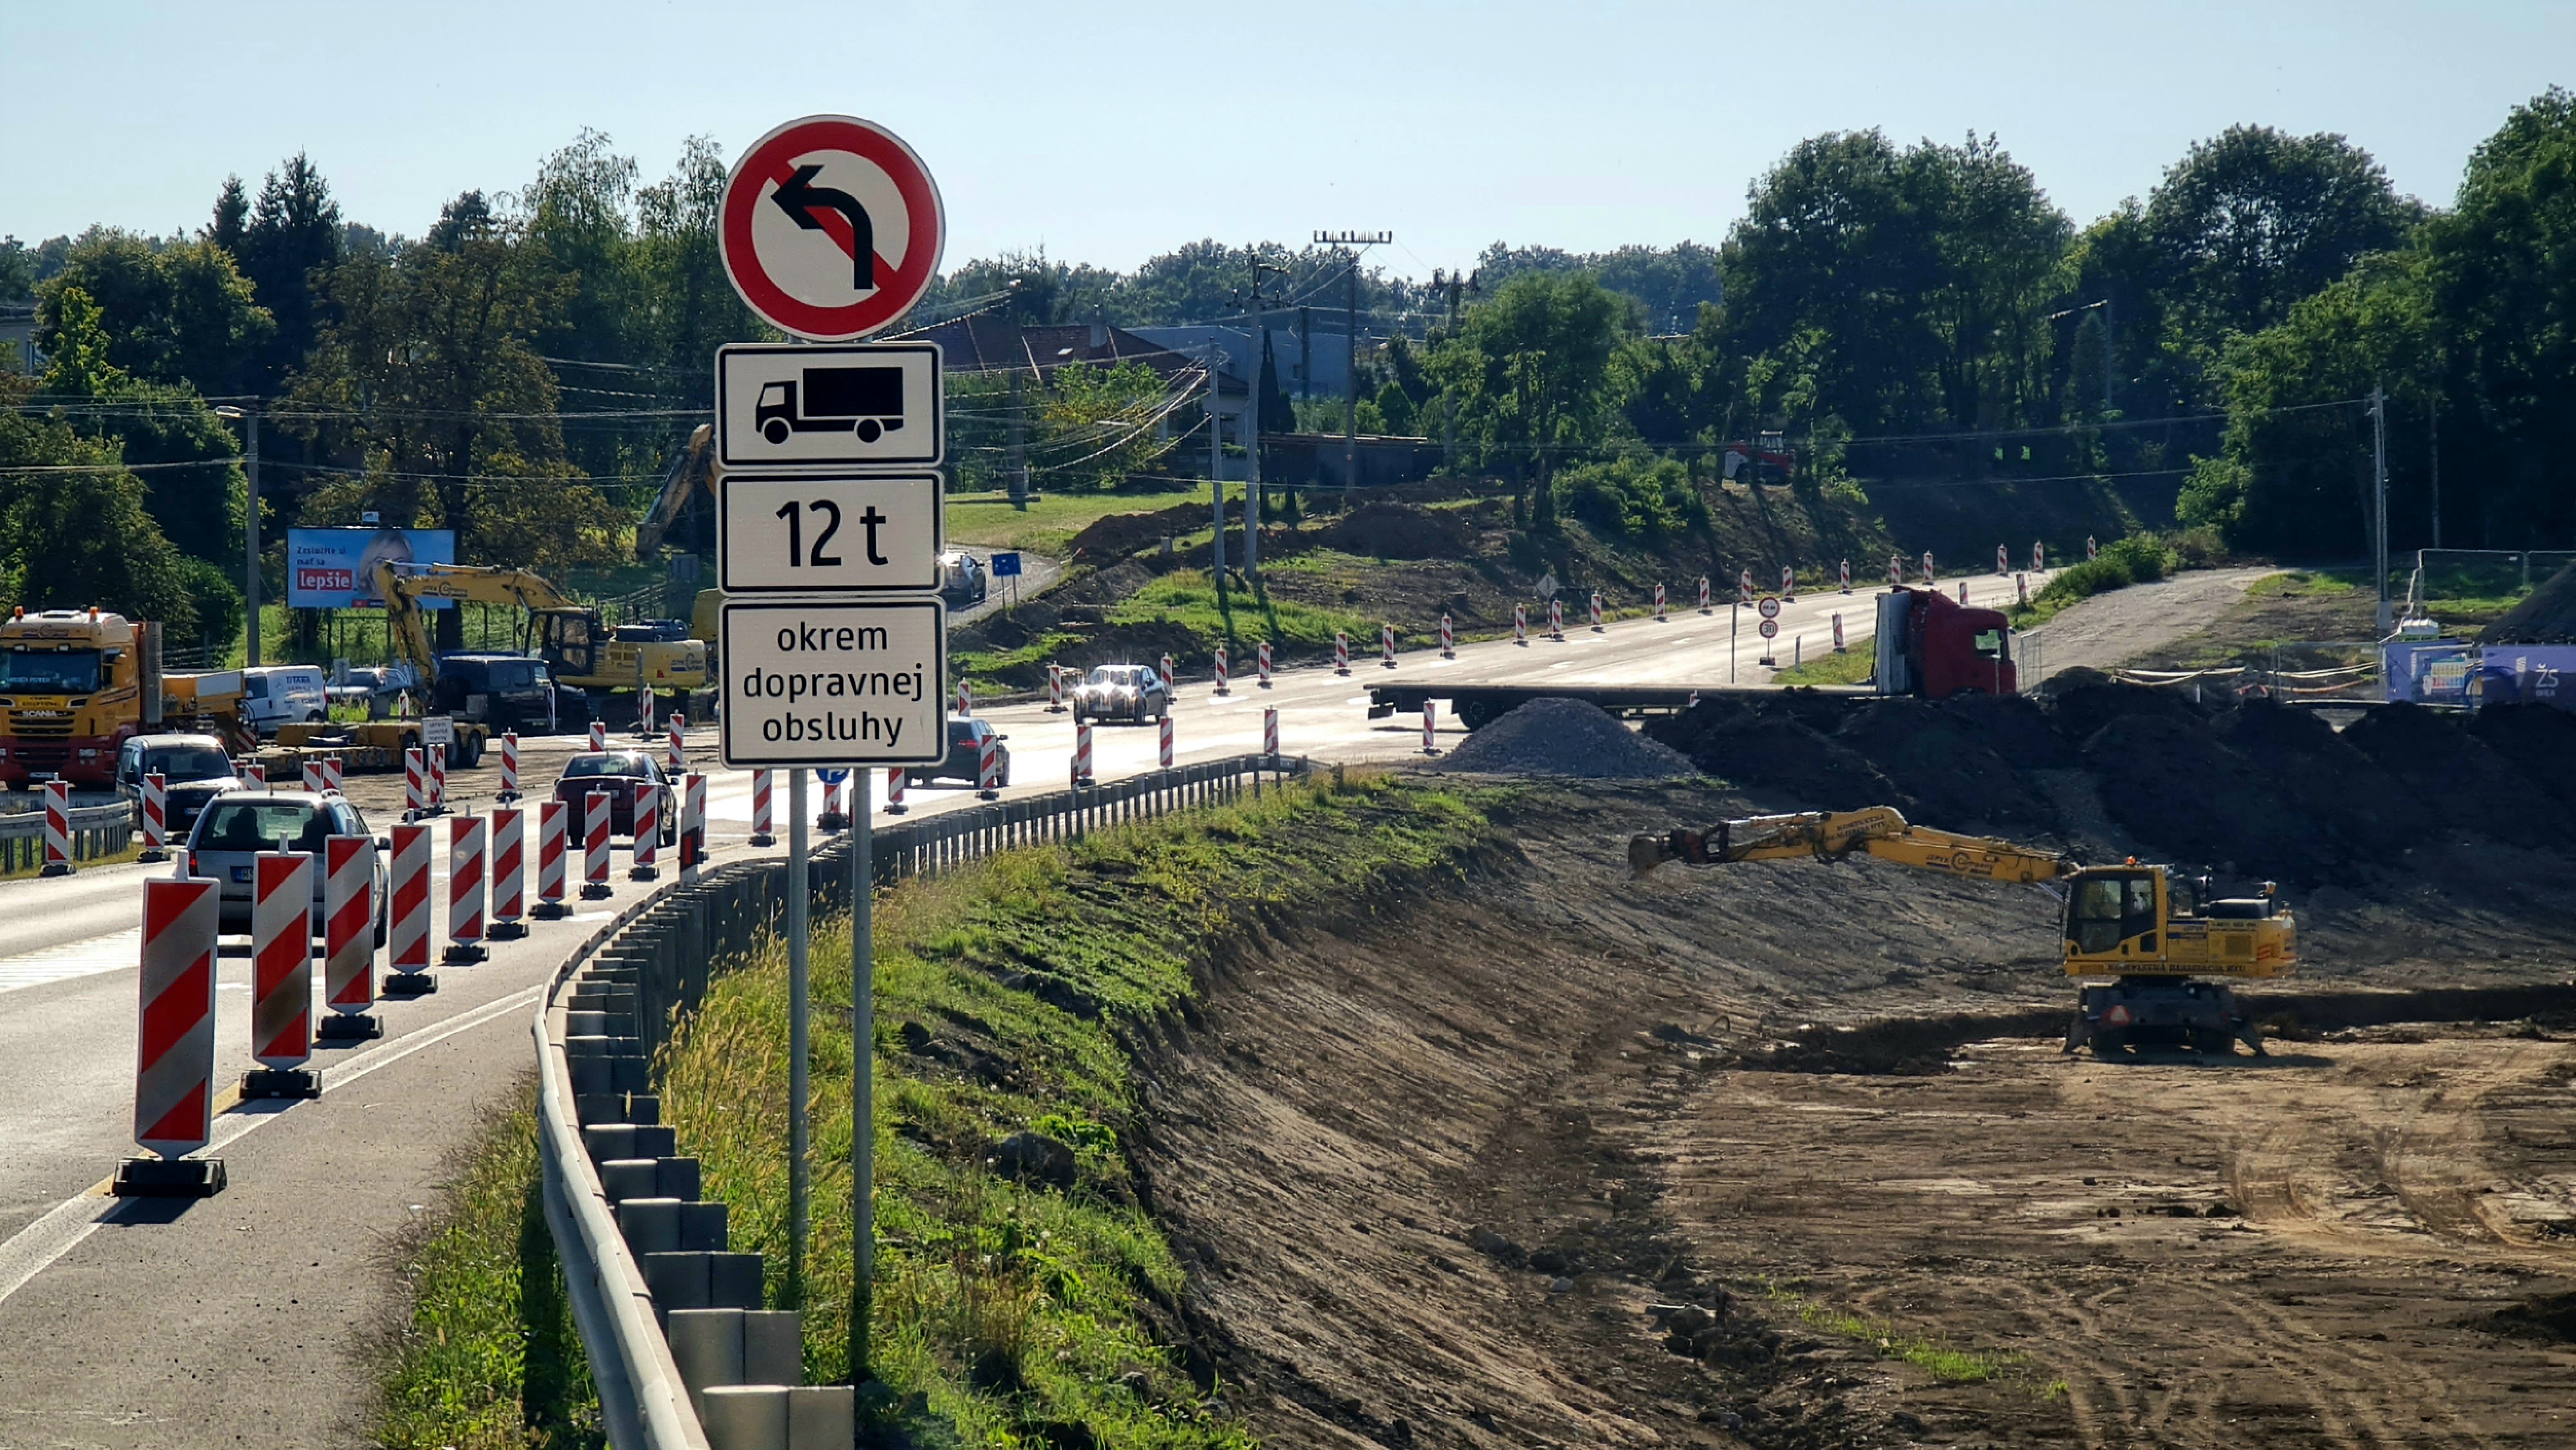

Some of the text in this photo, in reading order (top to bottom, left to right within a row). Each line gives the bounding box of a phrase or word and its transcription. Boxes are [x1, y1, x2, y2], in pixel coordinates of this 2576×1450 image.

[775, 499, 889, 567] 12 t
[300, 571, 350, 590] lepšie
[777, 621, 888, 652] okrem
[743, 663, 922, 704] dopravnej
[762, 711, 903, 748] obsluhy
